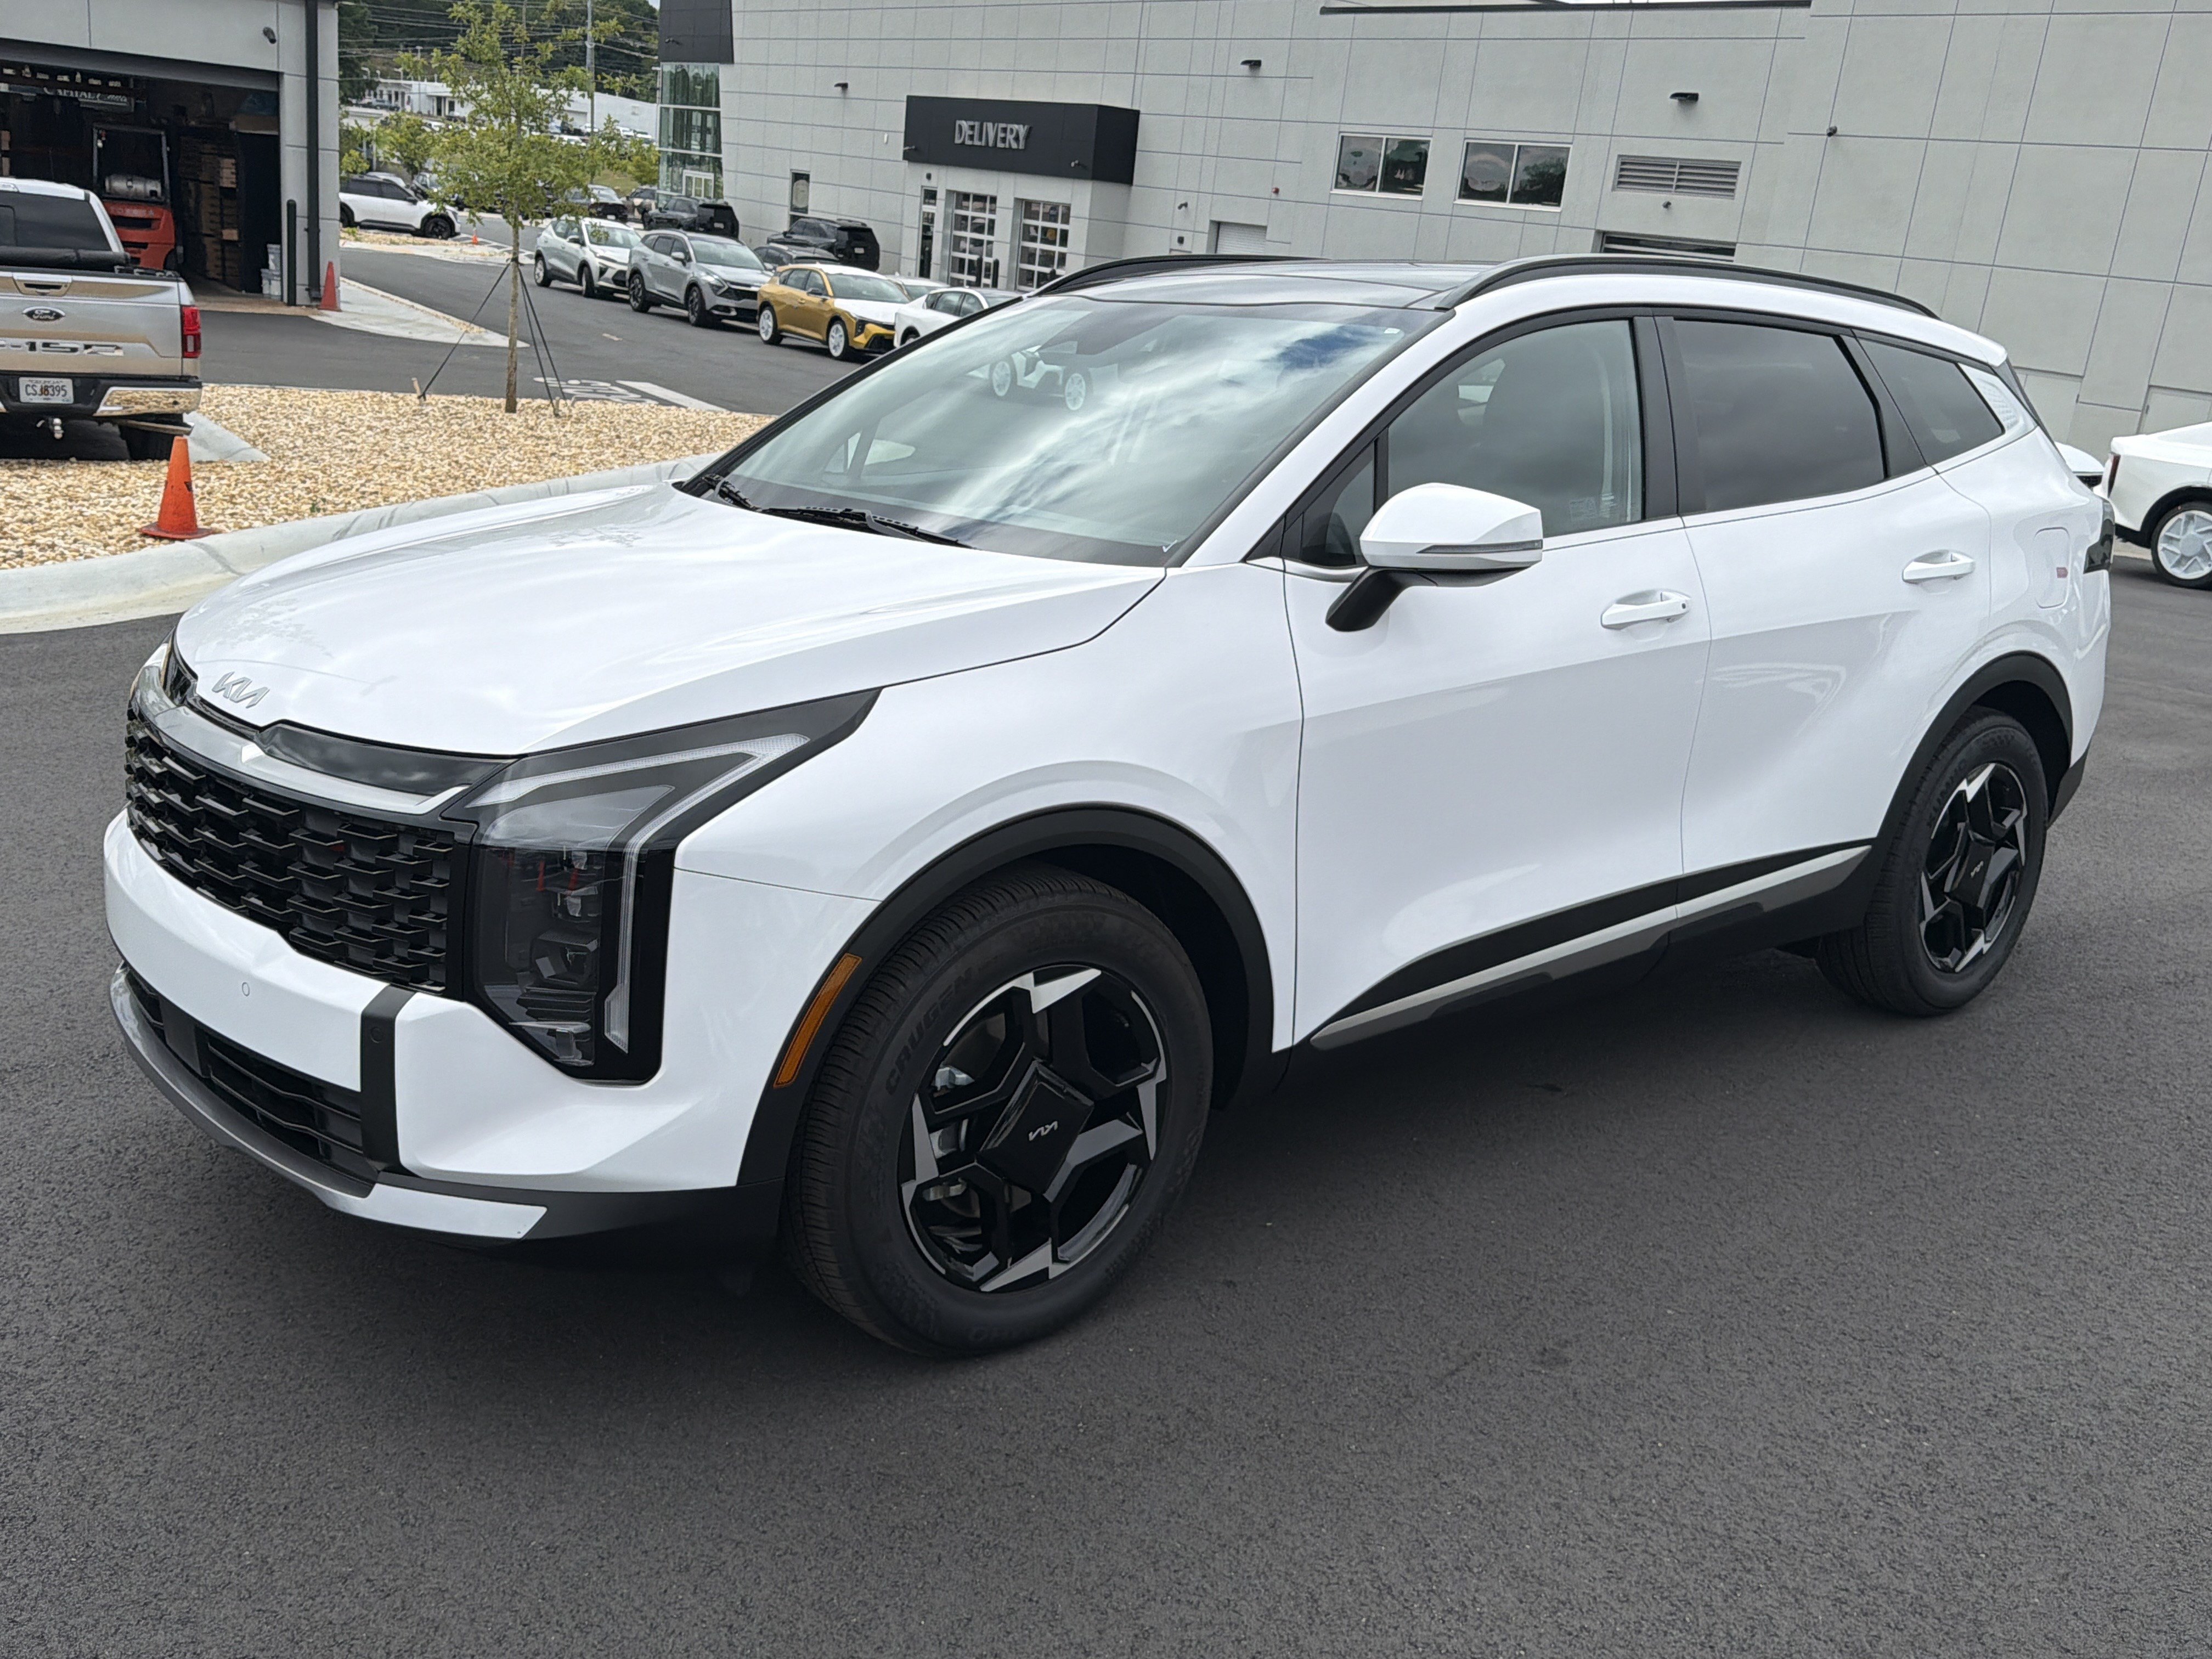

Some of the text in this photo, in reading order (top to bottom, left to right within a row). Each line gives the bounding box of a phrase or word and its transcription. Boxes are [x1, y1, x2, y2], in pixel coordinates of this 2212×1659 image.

[953, 120, 1030, 149] DELIVERY
[32, 308, 56, 319] Ford
[212, 671, 270, 709] KIA
[885, 967, 973, 1096] CRUGEN
[1029, 1121, 1058, 1141] KIA
